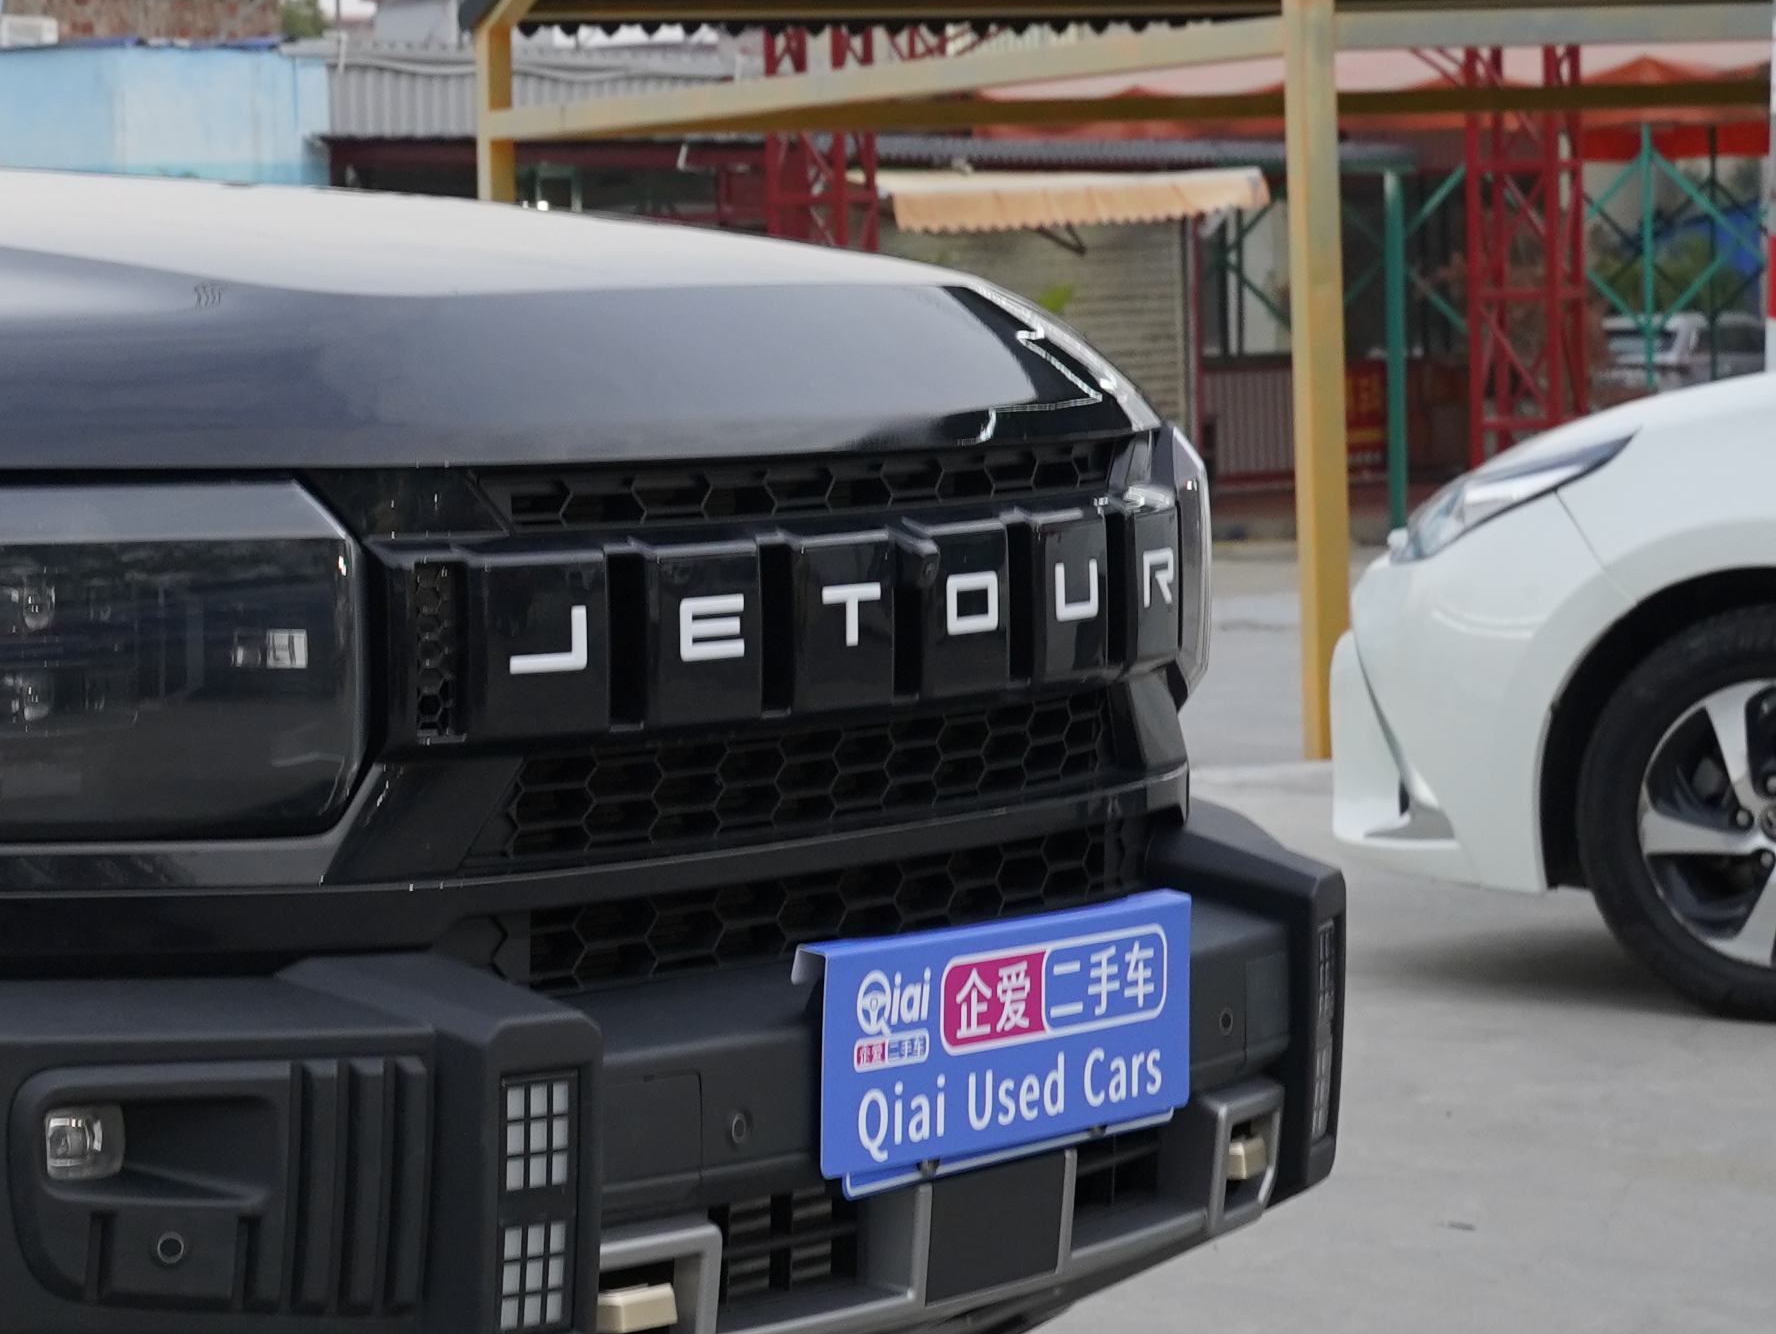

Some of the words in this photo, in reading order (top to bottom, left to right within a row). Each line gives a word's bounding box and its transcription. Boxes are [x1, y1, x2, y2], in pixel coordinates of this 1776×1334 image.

[509, 547, 1176, 675] JETOUR
[856, 966, 932, 1036] Qiai
[955, 939, 1155, 1041] 企爱二手车
[857, 1073, 946, 1163] Qiai
[967, 1050, 1066, 1132] Used
[1083, 1046, 1163, 1108] Cars
